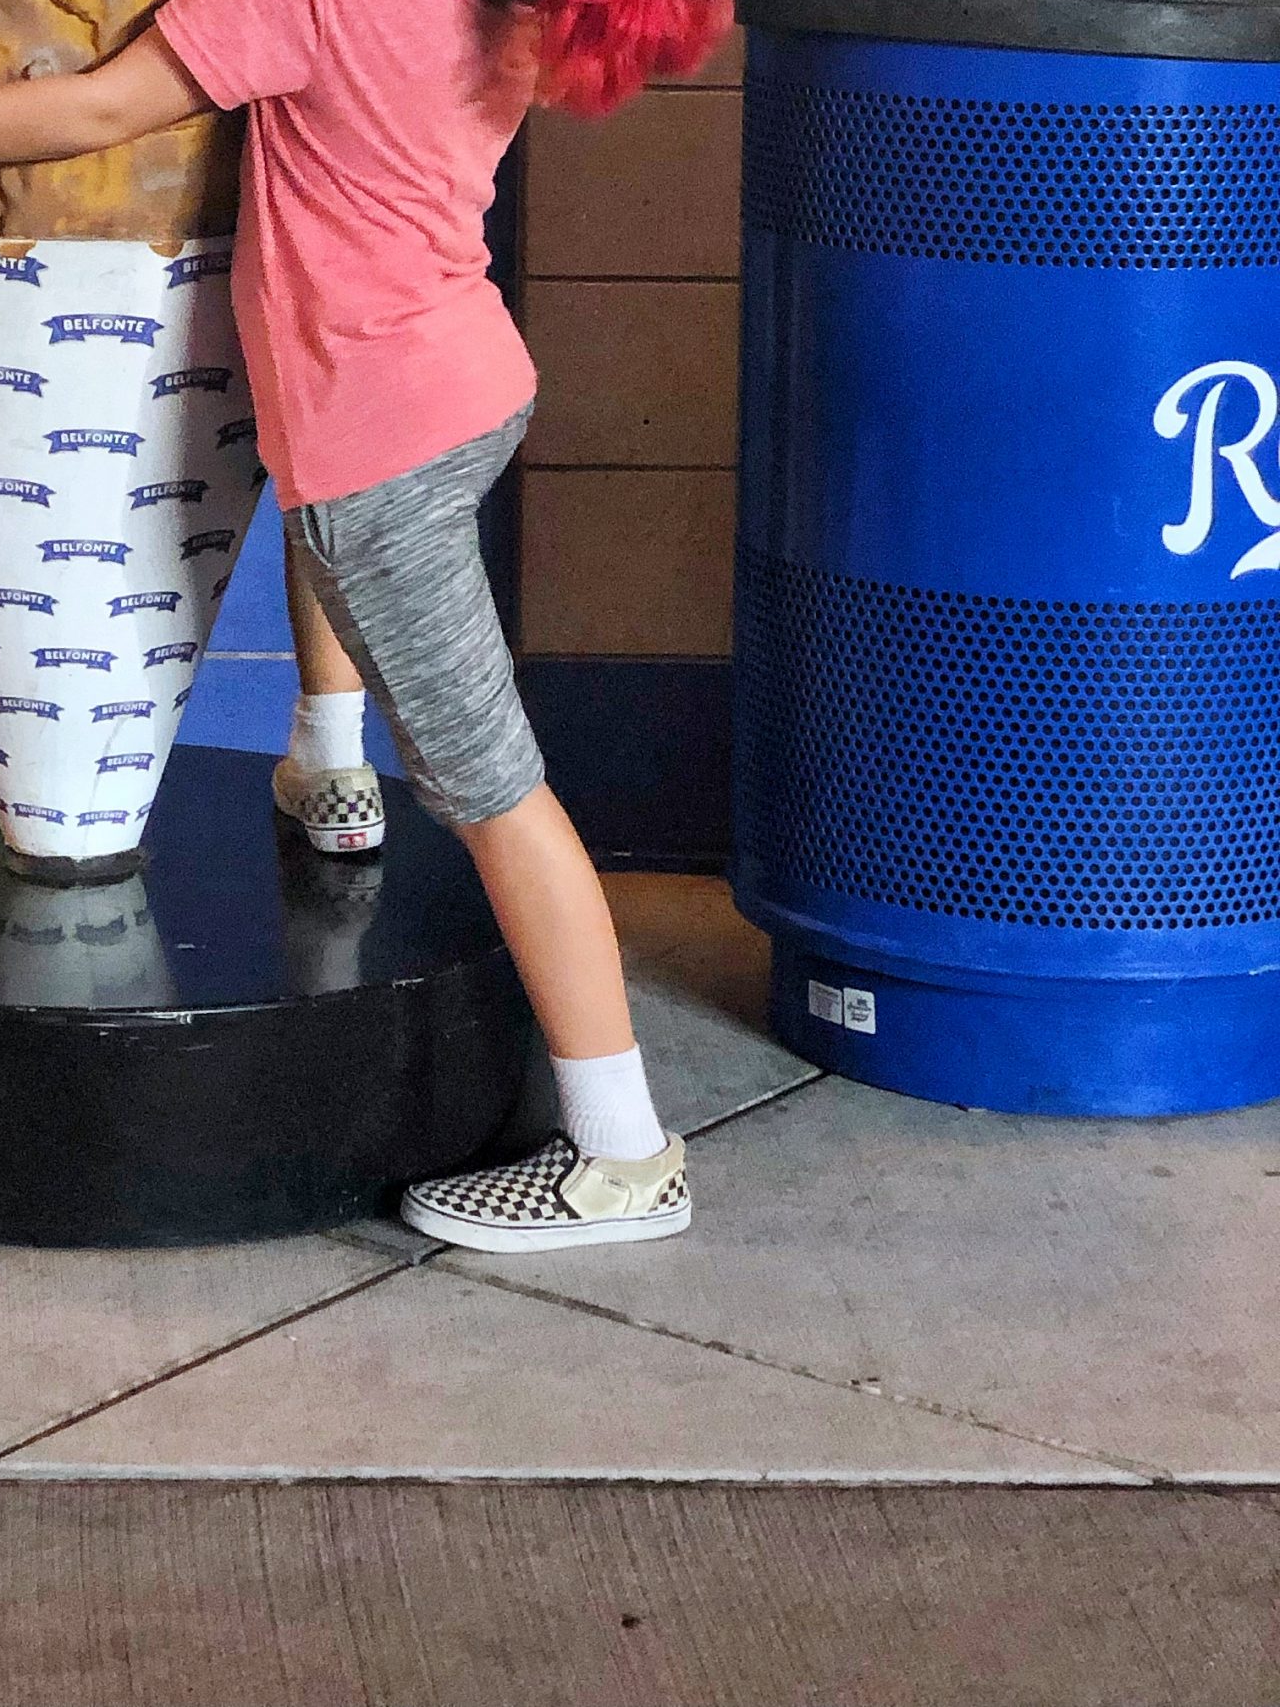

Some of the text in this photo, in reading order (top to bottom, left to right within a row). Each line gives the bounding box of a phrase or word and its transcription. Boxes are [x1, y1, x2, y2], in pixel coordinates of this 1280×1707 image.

[63, 318, 145, 333] BELFONTE
[60, 431, 130, 445] BELFONTE
[52, 542, 118, 555] BELFONTE
[120, 594, 172, 608] BELFONTE
[45, 650, 105, 663] BELFONTE
[2, 698, 51, 712] BELFONTE
[101, 702, 148, 715] BELFONTE
